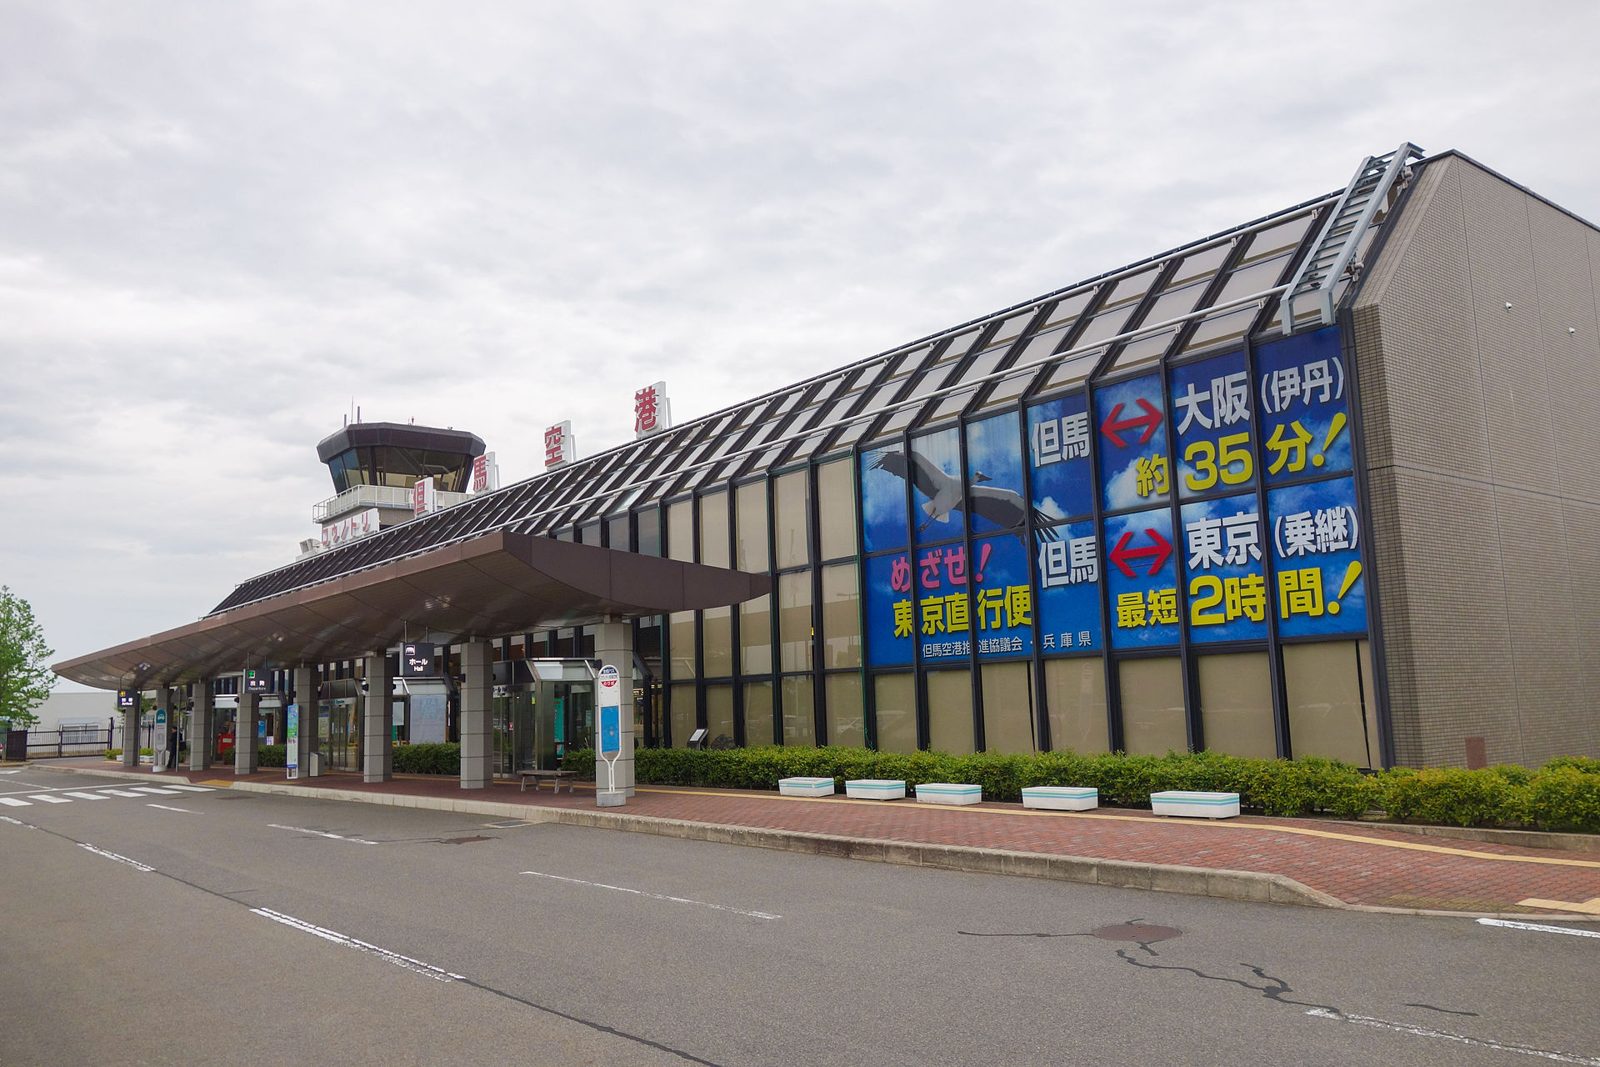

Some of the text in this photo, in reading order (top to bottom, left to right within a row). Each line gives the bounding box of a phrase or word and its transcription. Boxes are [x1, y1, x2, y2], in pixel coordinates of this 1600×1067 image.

[1032, 411, 1091, 468] 但馬
[321, 511, 369, 546] コウノトリ
[1038, 535, 1099, 589] 但馬
[893, 584, 1032, 638] 東京直行便
[1043, 630, 1092, 649] 兵庫県
[409, 658, 428, 666] ホール
